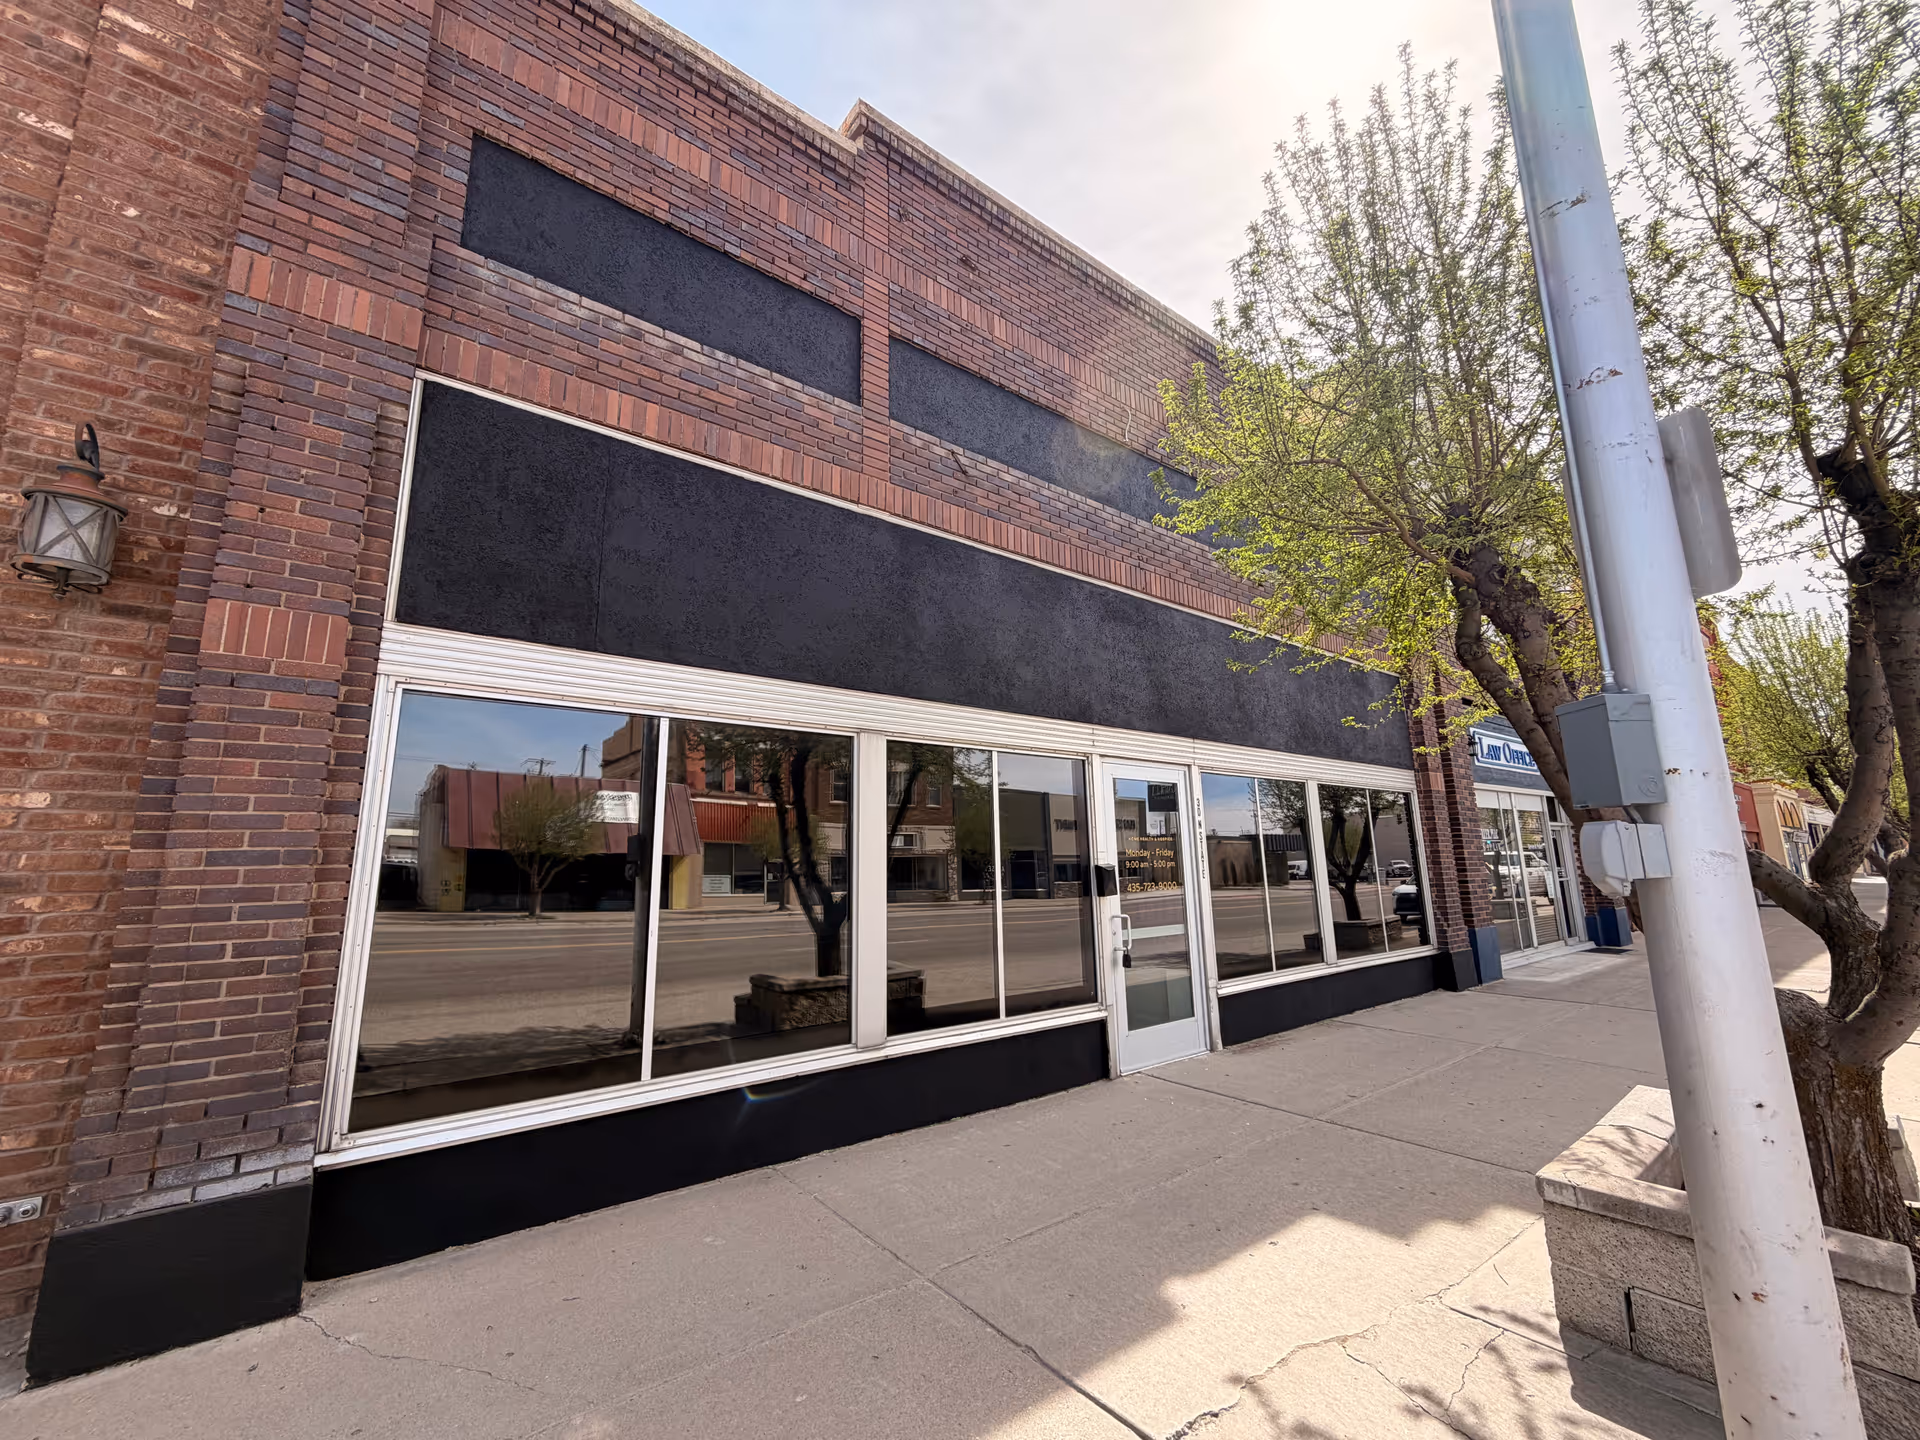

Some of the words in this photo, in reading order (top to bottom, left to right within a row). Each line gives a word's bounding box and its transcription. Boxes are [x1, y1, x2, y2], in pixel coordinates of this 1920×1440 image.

[1478, 737, 1501, 761] LAW
[1126, 849, 1150, 859] Monday
[1156, 848, 1174, 859] Friday
[1125, 860, 1140, 869] 9:00
[1153, 860, 1166, 868] 5:00
[1166, 861, 1176, 869] pm
[1127, 881, 1177, 892] 435-723-9000
